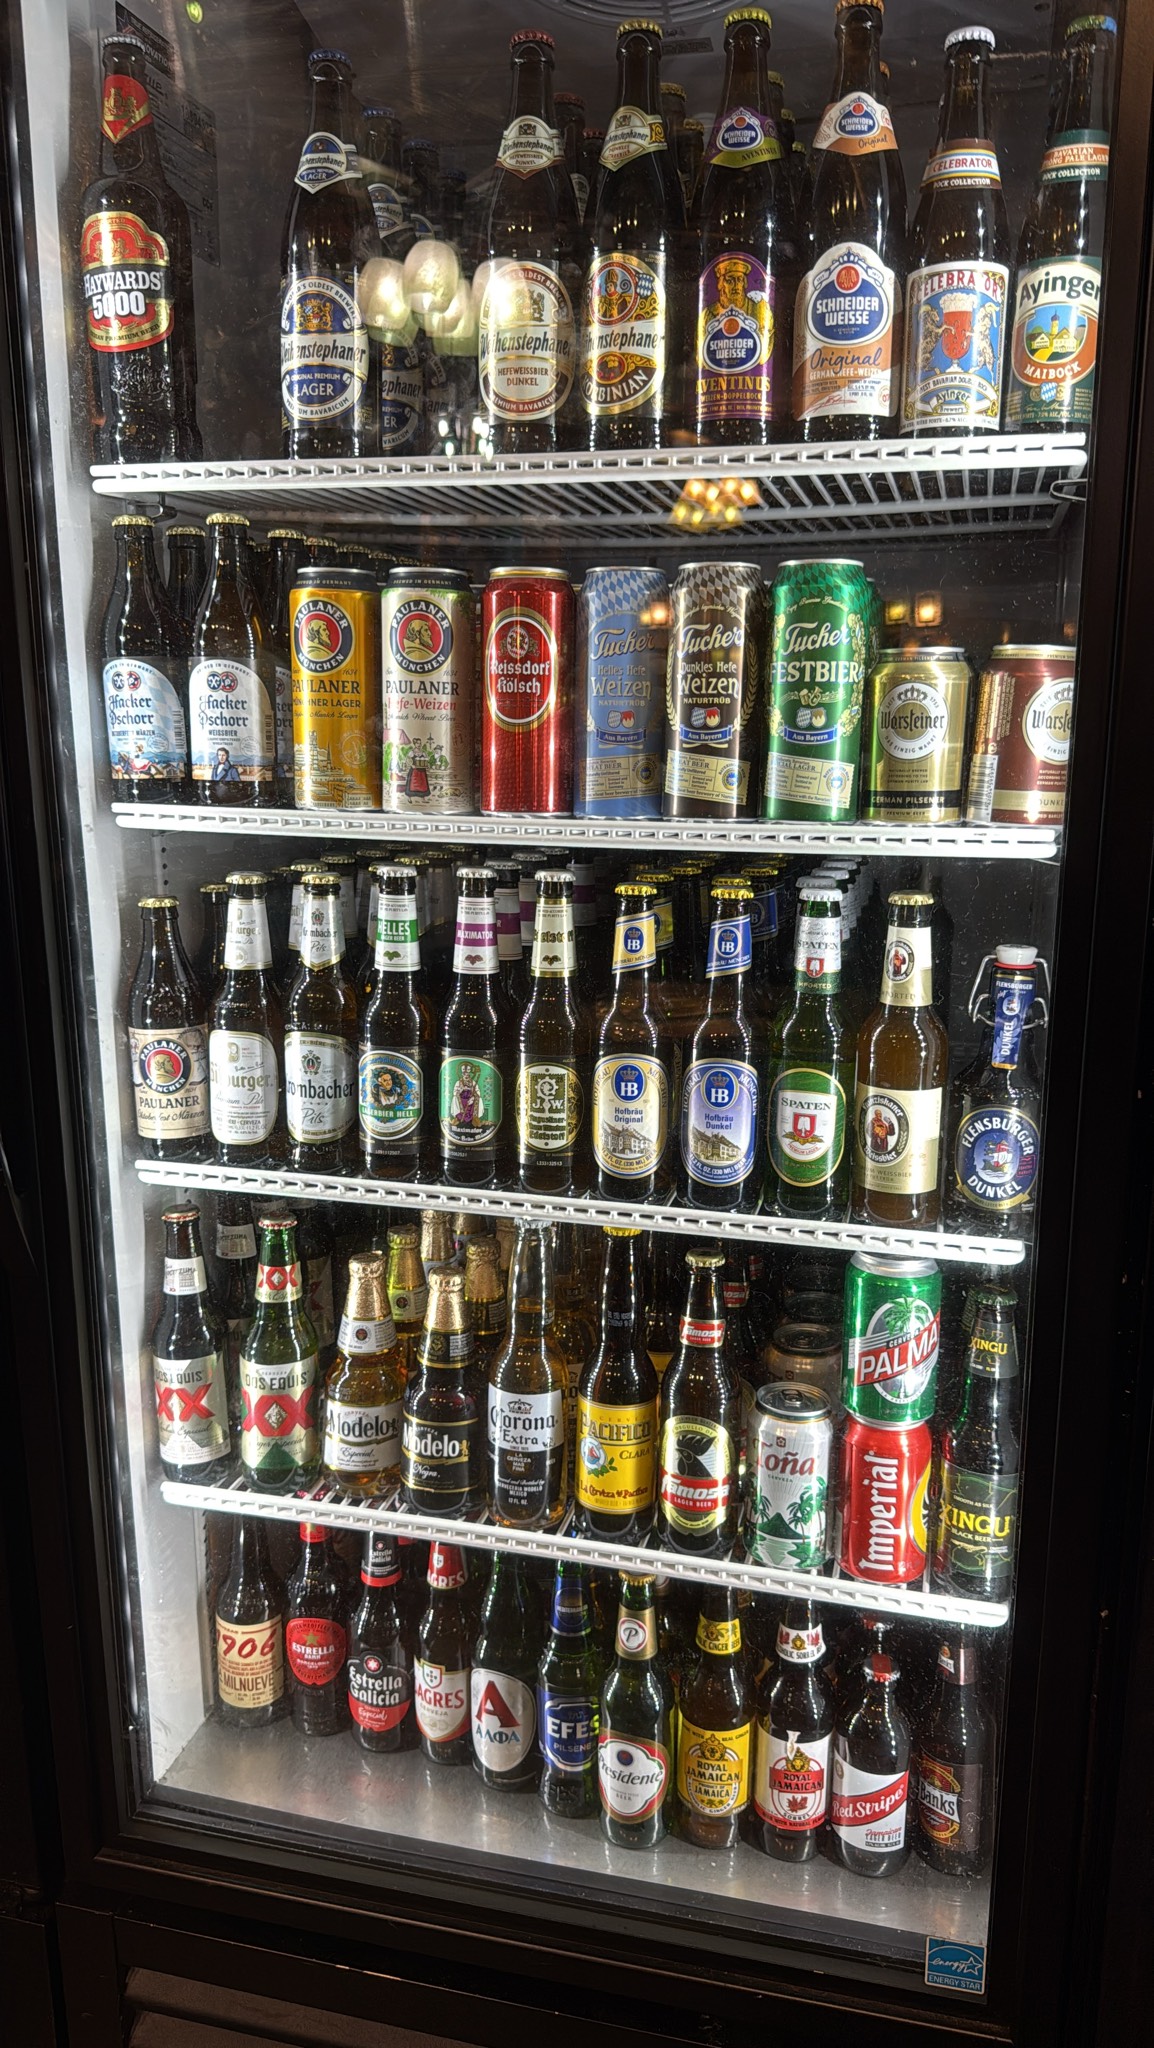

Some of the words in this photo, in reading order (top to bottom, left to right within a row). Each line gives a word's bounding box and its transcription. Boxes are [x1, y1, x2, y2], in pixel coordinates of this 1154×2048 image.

[841, 118, 873, 127] SCHNEIDER
[845, 124, 869, 132] WEISSE
[724, 130, 756, 139] SCHNEIDER
[728, 136, 750, 144] WEISSE
[858, 137, 888, 149] Original
[1054, 147, 1094, 158] BAVARIAN
[933, 156, 993, 172] CELEBRATOR
[1058, 168, 1100, 178] COLLECTION
[950, 178, 990, 187] COLLECTION
[84, 270, 161, 298] HAYWARDS
[308, 281, 334, 293] OLDEST
[1020, 271, 1101, 307] Ayinger
[92, 290, 146, 320] 5000
[816, 296, 879, 313] SCHNEIDER
[825, 311, 869, 327] WEISSE
[709, 338, 754, 351] SCHNEIDER
[716, 348, 747, 360] WEISSE
[810, 347, 882, 375] Original
[314, 373, 341, 381] PREMIUM
[498, 367, 549, 377] HEFEWEISSBIER
[809, 370, 835, 381] GERMAN
[1024, 362, 1081, 380] MAIBOCK
[293, 383, 334, 397] LAGER
[507, 378, 539, 387] DUNKEL
[695, 375, 771, 394] AVENTINUS
[310, 397, 349, 416] BAVARICUM
[295, 600, 347, 629] PAULANER
[392, 600, 449, 629] PAULANER
[591, 628, 655, 660] Tucher
[679, 622, 744, 656] Tucher
[781, 621, 850, 655] Tucher
[297, 652, 345, 672] MÜNCHEN
[395, 653, 445, 672] MÜNCHEN
[490, 660, 551, 677] Reissdorf
[597, 664, 623, 675] Helles
[626, 664, 646, 674] Hefe
[680, 660, 713, 675] Dunkles
[716, 660, 737, 674] Hefe
[770, 660, 859, 683] FESTBIER
[292, 679, 361, 695] PAULANER
[386, 679, 459, 696] PAULANER
[497, 676, 542, 697] Kölsch
[590, 677, 651, 699] Weizen
[680, 674, 739, 698] Weizen
[331, 699, 361, 709] LAGER
[598, 699, 646, 707] NATURTRÜB
[683, 697, 731, 705] NATURTRÜB
[108, 711, 154, 729] Pschorr
[199, 711, 248, 730] Pschorr
[412, 713, 437, 721] Wheat
[880, 708, 945, 732] Warsteiner
[1031, 709, 1072, 733] Warste
[616, 734, 638, 743] Bayern
[688, 732, 699, 740] Aus
[700, 732, 722, 742] Bayern
[806, 733, 828, 742] Bayern
[893, 743, 916, 753] EINZIG
[692, 760, 710, 769] BEER
[794, 762, 816, 772] LAGER
[871, 796, 902, 805] GERMAN
[905, 796, 945, 805] PILSENER
[377, 921, 411, 935] HELLES
[457, 929, 494, 940] MAXIMATOR
[311, 942, 327, 953] Pils
[627, 939, 641, 951] HB
[721, 941, 735, 953] HB
[797, 940, 838, 951] SPATEN
[797, 982, 832, 990] IMPORTED
[996, 980, 1033, 990] FLENSBURGER
[1002, 1020, 1016, 1057] DUNKEL
[141, 1040, 187, 1060] PAULANER
[145, 1077, 186, 1092] MÜNCHEN
[620, 1082, 638, 1097] HB
[140, 1096, 200, 1110] PAULANER
[711, 1088, 729, 1103] HB
[614, 1107, 643, 1116] Hofbräu
[781, 1097, 831, 1111] SPATEN
[171, 1110, 205, 1121] Märzen
[300, 1108, 325, 1125] Pils
[397, 1109, 414, 1118] HELL
[614, 1115, 643, 1125] Original
[704, 1113, 734, 1122] Hofbräu
[706, 1121, 732, 1130] Dunkel
[962, 1117, 1035, 1156] FLENSBURGER
[967, 1175, 1022, 1198] DUNKEL
[681, 1325, 724, 1339] Famosa
[859, 1320, 940, 1382] PALMA
[969, 1335, 1008, 1355] XINGU
[270, 1371, 309, 1391] EQUIS
[155, 1383, 215, 1422] XX
[327, 1408, 390, 1438] Modelo
[490, 1405, 556, 1432] Corona
[403, 1422, 460, 1458] Modelo
[502, 1429, 538, 1446] Extra
[340, 1446, 375, 1459] Especial
[619, 1447, 650, 1460] CLARA
[661, 1475, 730, 1500] Famosa
[673, 1496, 694, 1506] LAGER
[696, 1500, 711, 1508] BEER
[858, 1452, 900, 1572] Imperial
[939, 1500, 1012, 1538] XINGU
[951, 1528, 974, 1541] BLACK
[975, 1534, 992, 1542] BEER
[292, 1641, 335, 1656] ESTRELLA
[708, 1641, 729, 1652] GINGER
[349, 1665, 402, 1690] Estrella
[350, 1681, 400, 1706] Galicia
[547, 1714, 600, 1740] EFES
[600, 1754, 664, 1786] Presidente
[696, 1760, 728, 1772] ROYAL
[687, 1766, 740, 1782] JAMAICAN
[783, 1772, 812, 1782] ROYAL
[694, 1787, 730, 1798] JAMAICA
[772, 1779, 822, 1792] JAMAICAN
[832, 1799, 854, 1818] Red
[855, 1787, 904, 1818] Stripe
[920, 1783, 956, 1817] Banks
[928, 1974, 959, 1987] ENERGY
[960, 1980, 981, 1990] STAR
